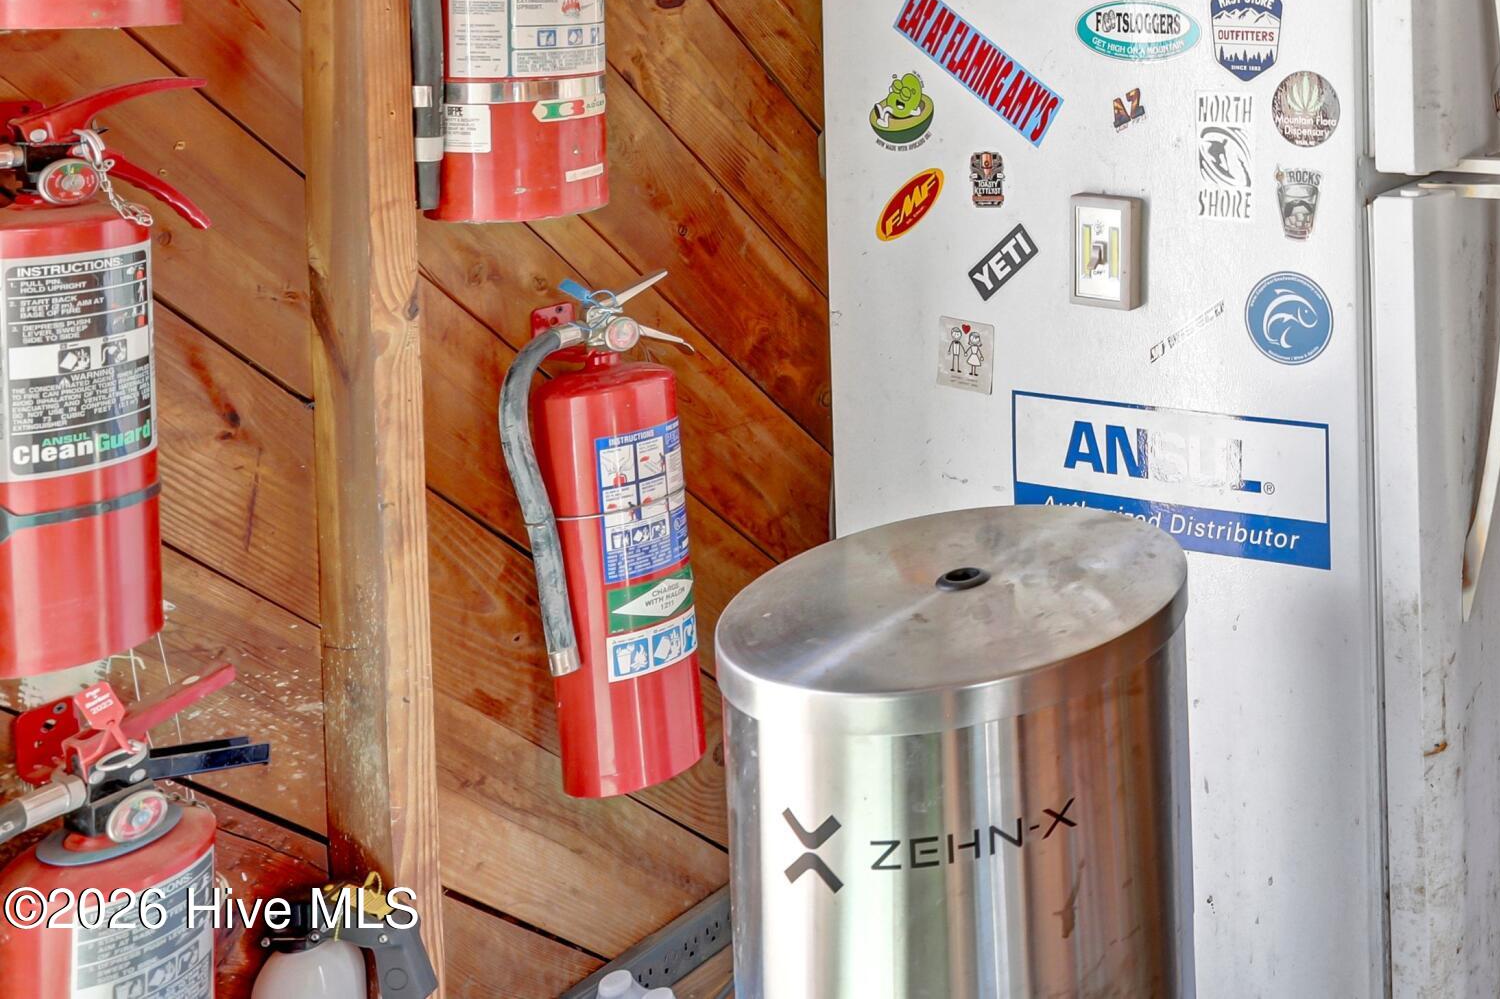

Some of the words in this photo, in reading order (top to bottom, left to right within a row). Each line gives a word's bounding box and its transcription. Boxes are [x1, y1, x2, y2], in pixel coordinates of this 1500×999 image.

[1092, 37, 1107, 49] GET
[1107, 42, 1126, 54] HIGH
[1218, 28, 1275, 42] OUTFITTERS
[921, 7, 956, 57] AT
[940, 20, 1015, 107] FLAMING
[997, 69, 1060, 143] AMY'S
[1199, 95, 1252, 123] NORTH
[1275, 114, 1314, 126] Mountain
[1284, 127, 1330, 141] Dispensary
[885, 171, 937, 237] FMF
[1199, 188, 1252, 219] SHORE
[972, 232, 1032, 292] YETI
[70, 367, 114, 381] WARNING
[12, 419, 151, 465] CleanGuard
[42, 432, 91, 447] ANSUL
[1170, 513, 1300, 550] Distributor
[869, 797, 1078, 872] ZEHN-X
